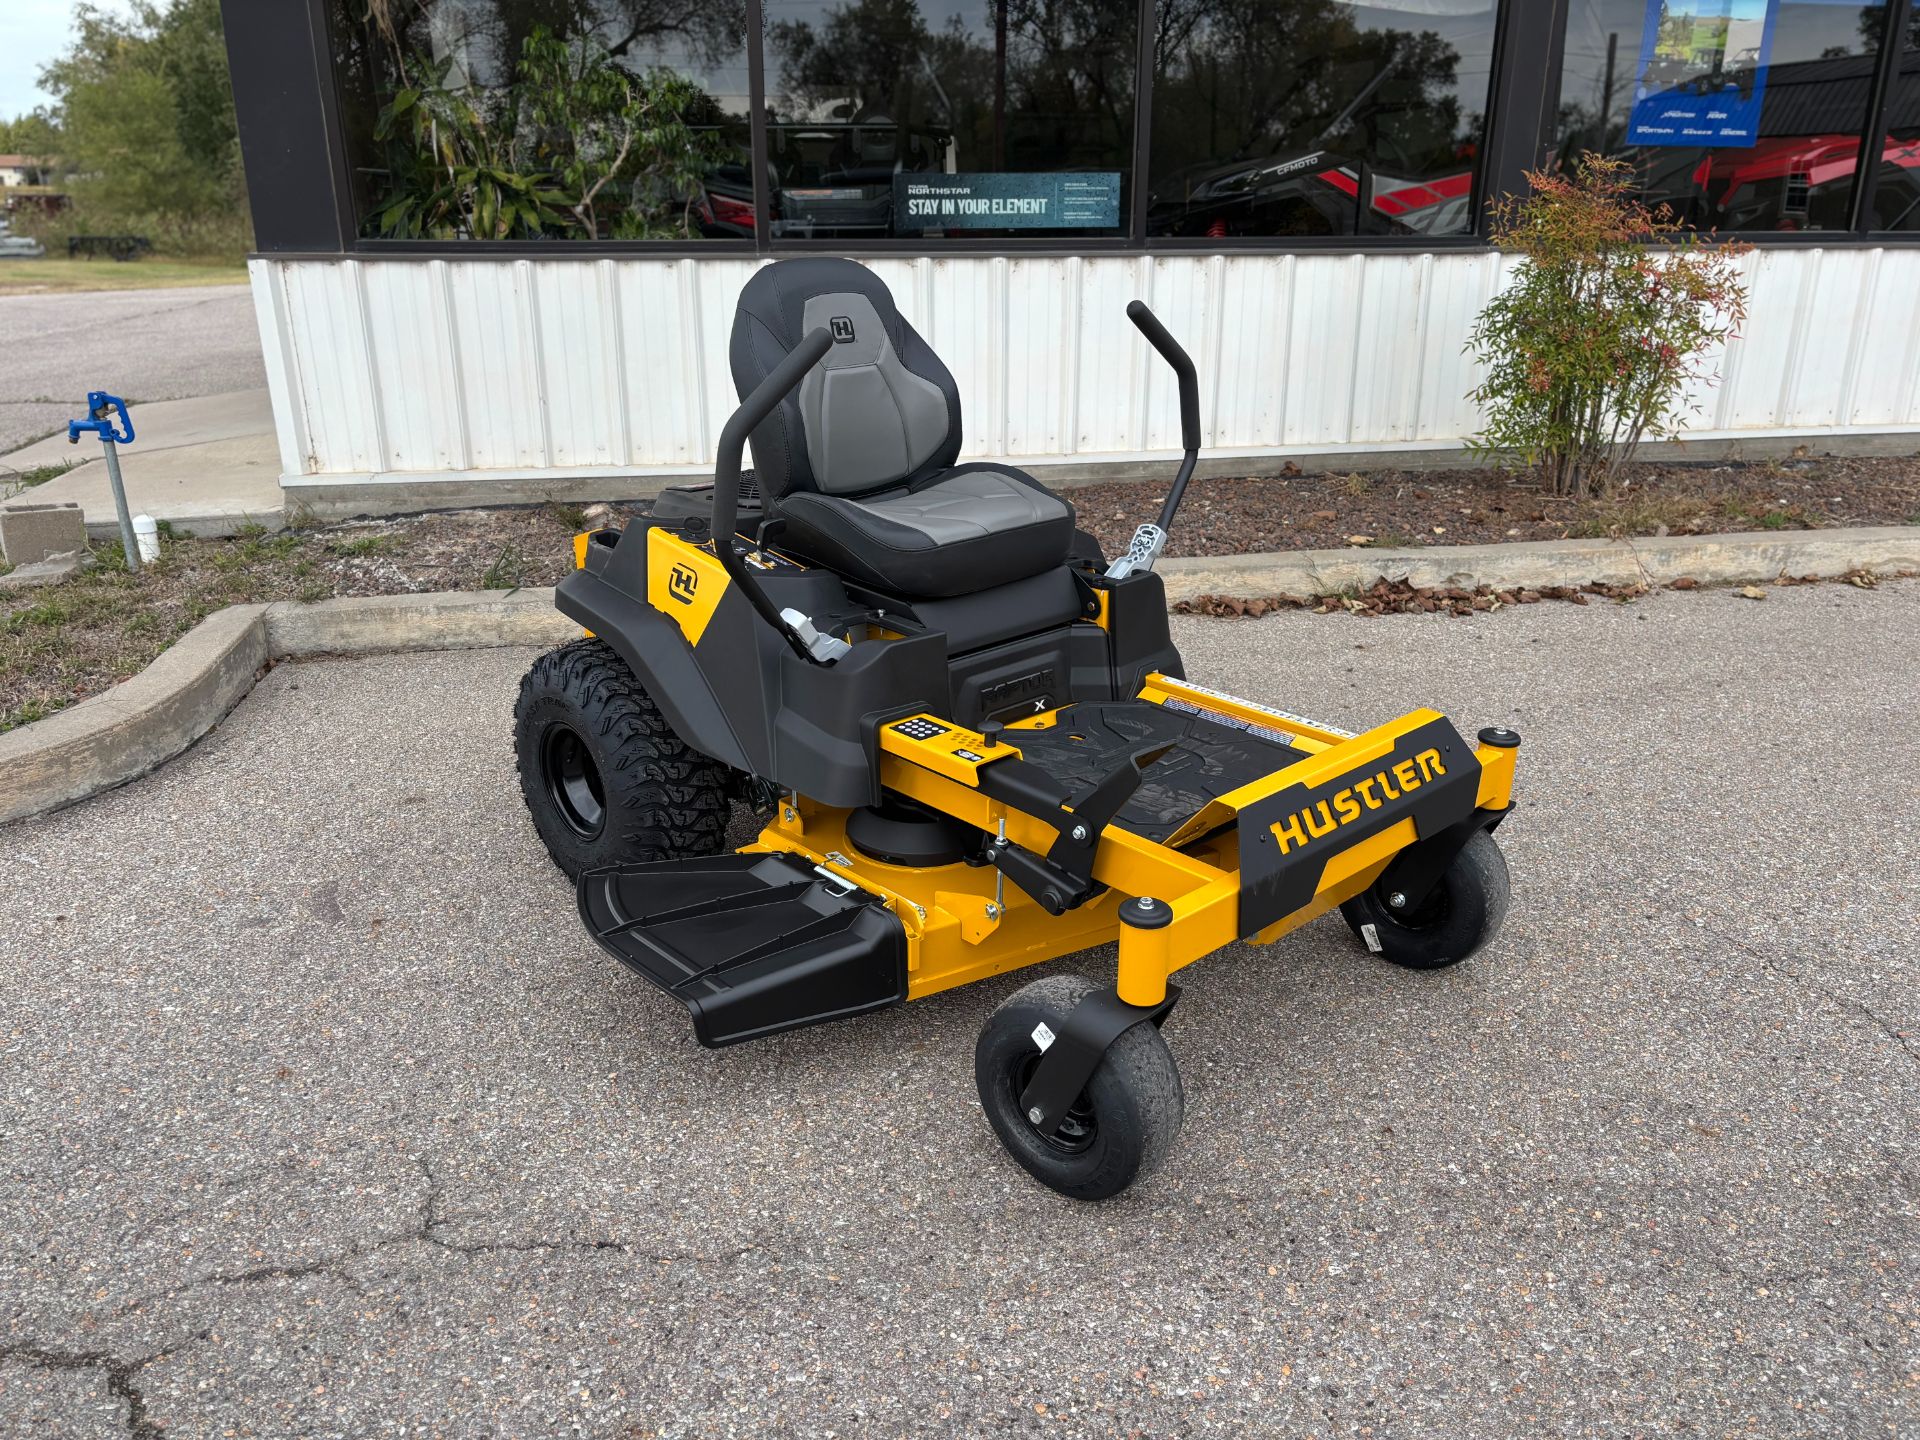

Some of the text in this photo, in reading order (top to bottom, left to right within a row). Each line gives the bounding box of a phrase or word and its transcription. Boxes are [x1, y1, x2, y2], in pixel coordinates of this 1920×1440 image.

[1277, 157, 1318, 175] CFMOTO
[908, 198, 1048, 215] STAY IN YOUR ELEMENT
[1034, 699, 1046, 712] X
[1269, 747, 1448, 855] HUSTLER
